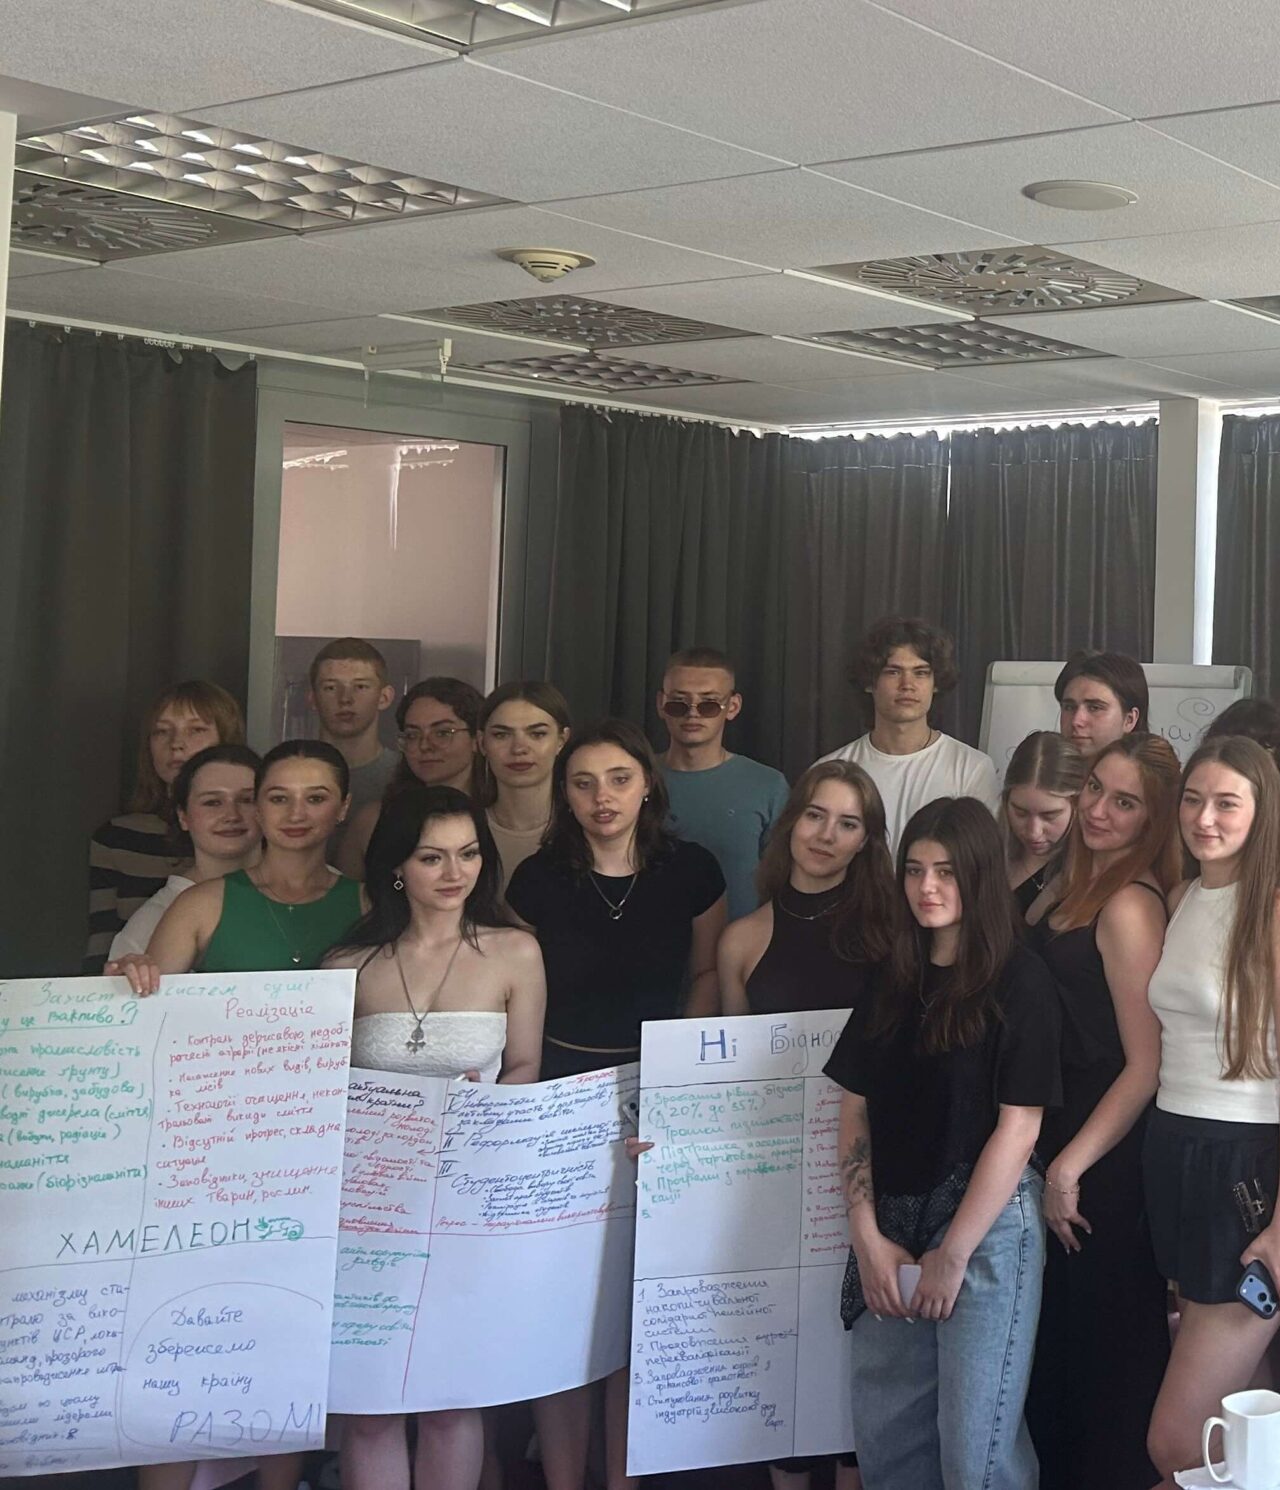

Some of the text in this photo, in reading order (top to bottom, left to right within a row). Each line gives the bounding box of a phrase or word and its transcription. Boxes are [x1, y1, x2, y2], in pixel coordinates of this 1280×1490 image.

[700, 1028, 738, 1062] Ні
[56, 1217, 250, 1259] ХАМЕЛЕОН
[170, 1306, 244, 1328] Давайте
[142, 1372, 253, 1397] нашу країну
